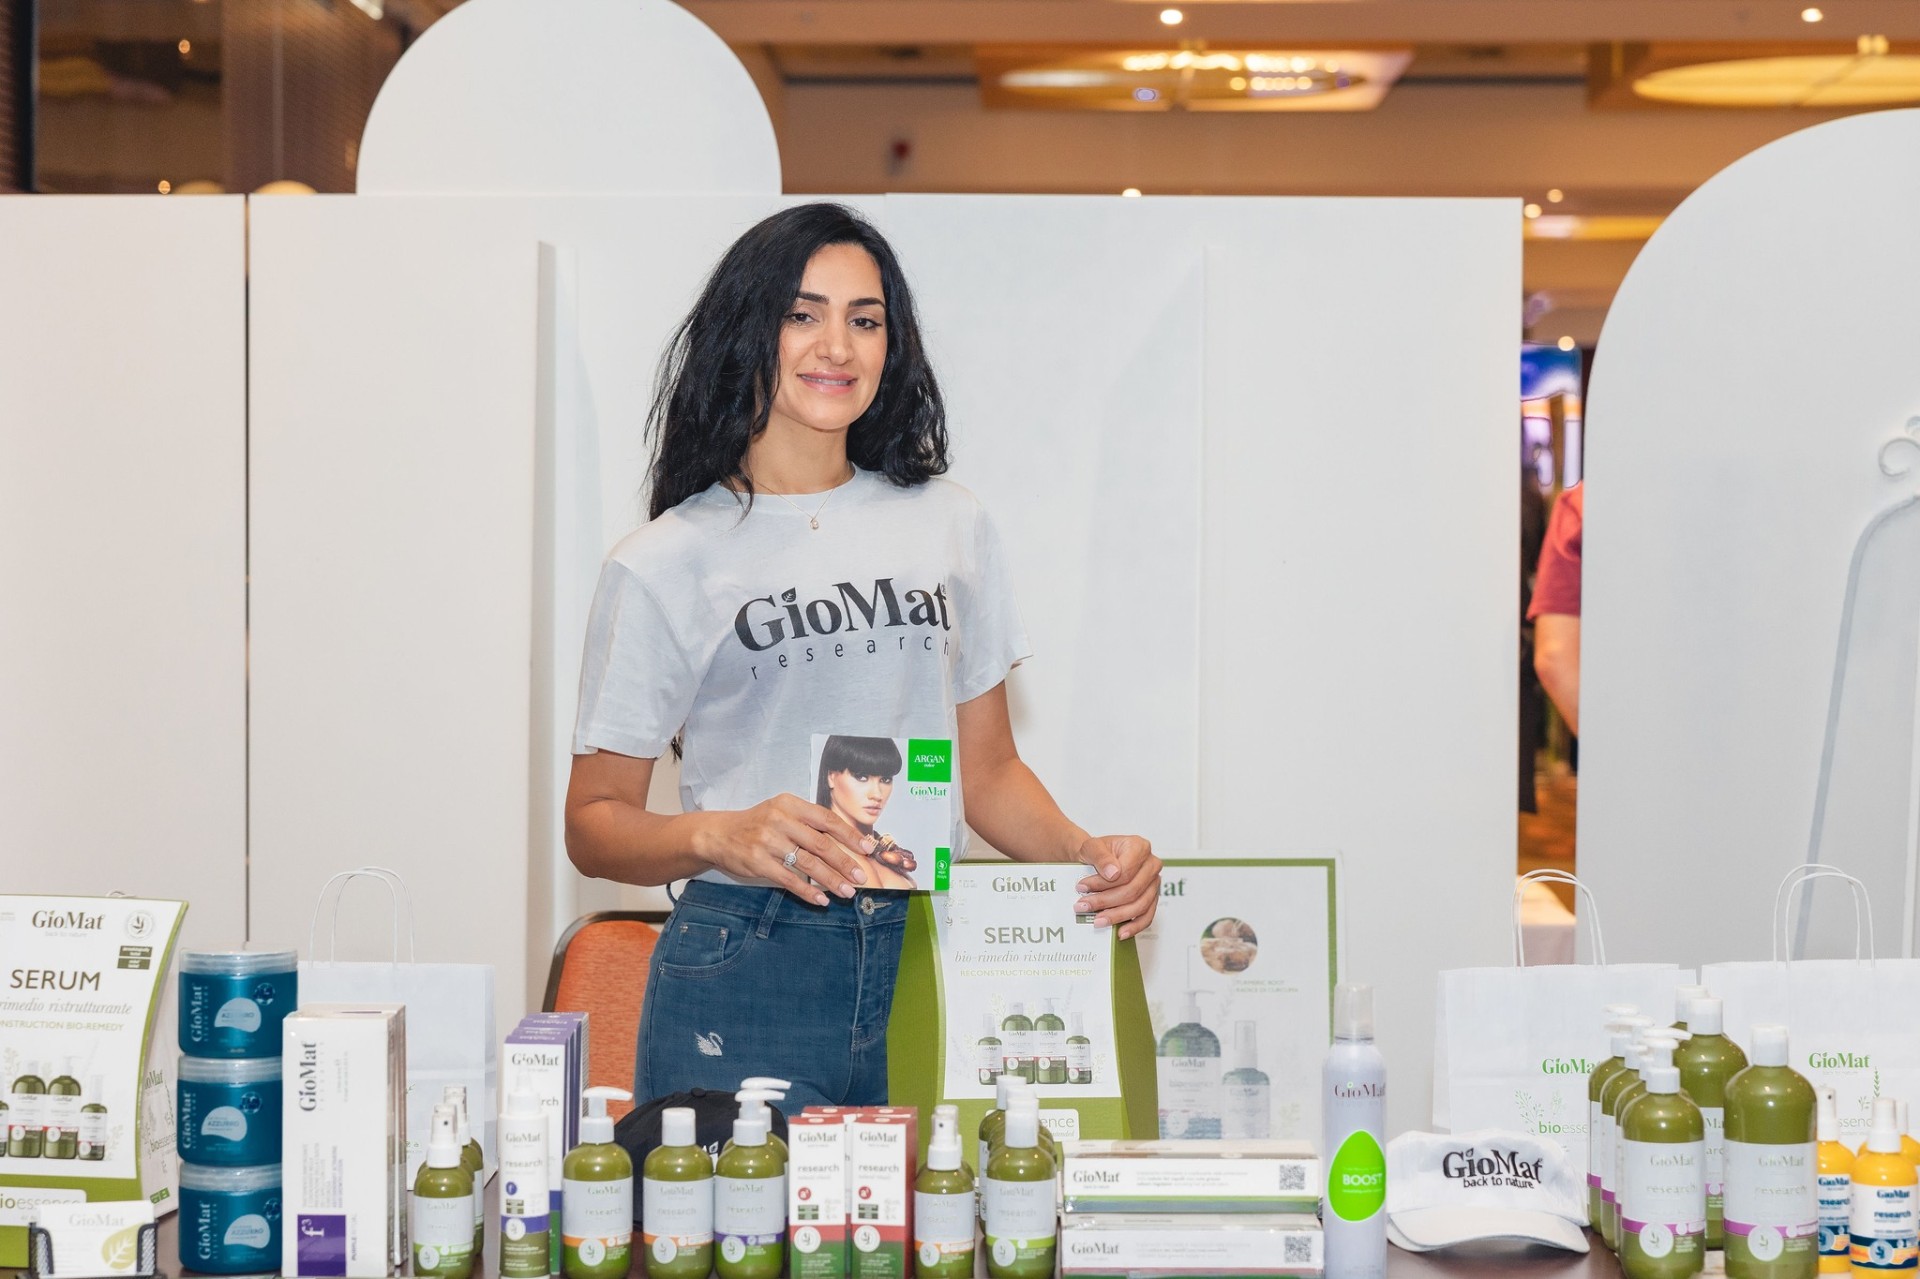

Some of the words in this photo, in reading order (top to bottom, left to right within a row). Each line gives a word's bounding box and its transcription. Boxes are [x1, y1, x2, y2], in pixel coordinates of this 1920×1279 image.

[734, 577, 952, 651] GioMat
[750, 636, 950, 680] research
[914, 755, 945, 764] ARGAN
[910, 786, 948, 797] GioMat
[992, 877, 1056, 893] GioMat
[32, 910, 105, 930] GioMat
[983, 926, 1065, 944] SERUM
[954, 950, 1020, 963] bio-rimedio
[1023, 950, 1099, 963] ristrutturante
[10, 968, 101, 991] SERUM
[960, 967, 1040, 977] RECONSTRUCTION
[1042, 967, 1093, 976] BIO-REMEDY
[49, 998, 133, 1015] ristrutturante
[190, 985, 203, 1042] GioMat
[1541, 1058, 1600, 1075] GioMa
[1808, 1053, 1871, 1069] GioMat
[299, 1042, 317, 1112] GioMat
[505, 1132, 541, 1144] GioMat
[797, 1131, 837, 1143] GioMat
[859, 1130, 898, 1142] GioMat
[797, 1163, 840, 1175] research
[858, 1162, 900, 1175] research
[1442, 1147, 1543, 1184] GioMat
[1072, 1170, 1121, 1184] GioMat
[1342, 1173, 1384, 1187] BOOST
[1463, 1176, 1488, 1189] back
[1491, 1175, 1503, 1187] to
[1505, 1177, 1535, 1190] nature
[198, 1202, 212, 1260] GioMat
[1070, 1241, 1120, 1255] GioMat
